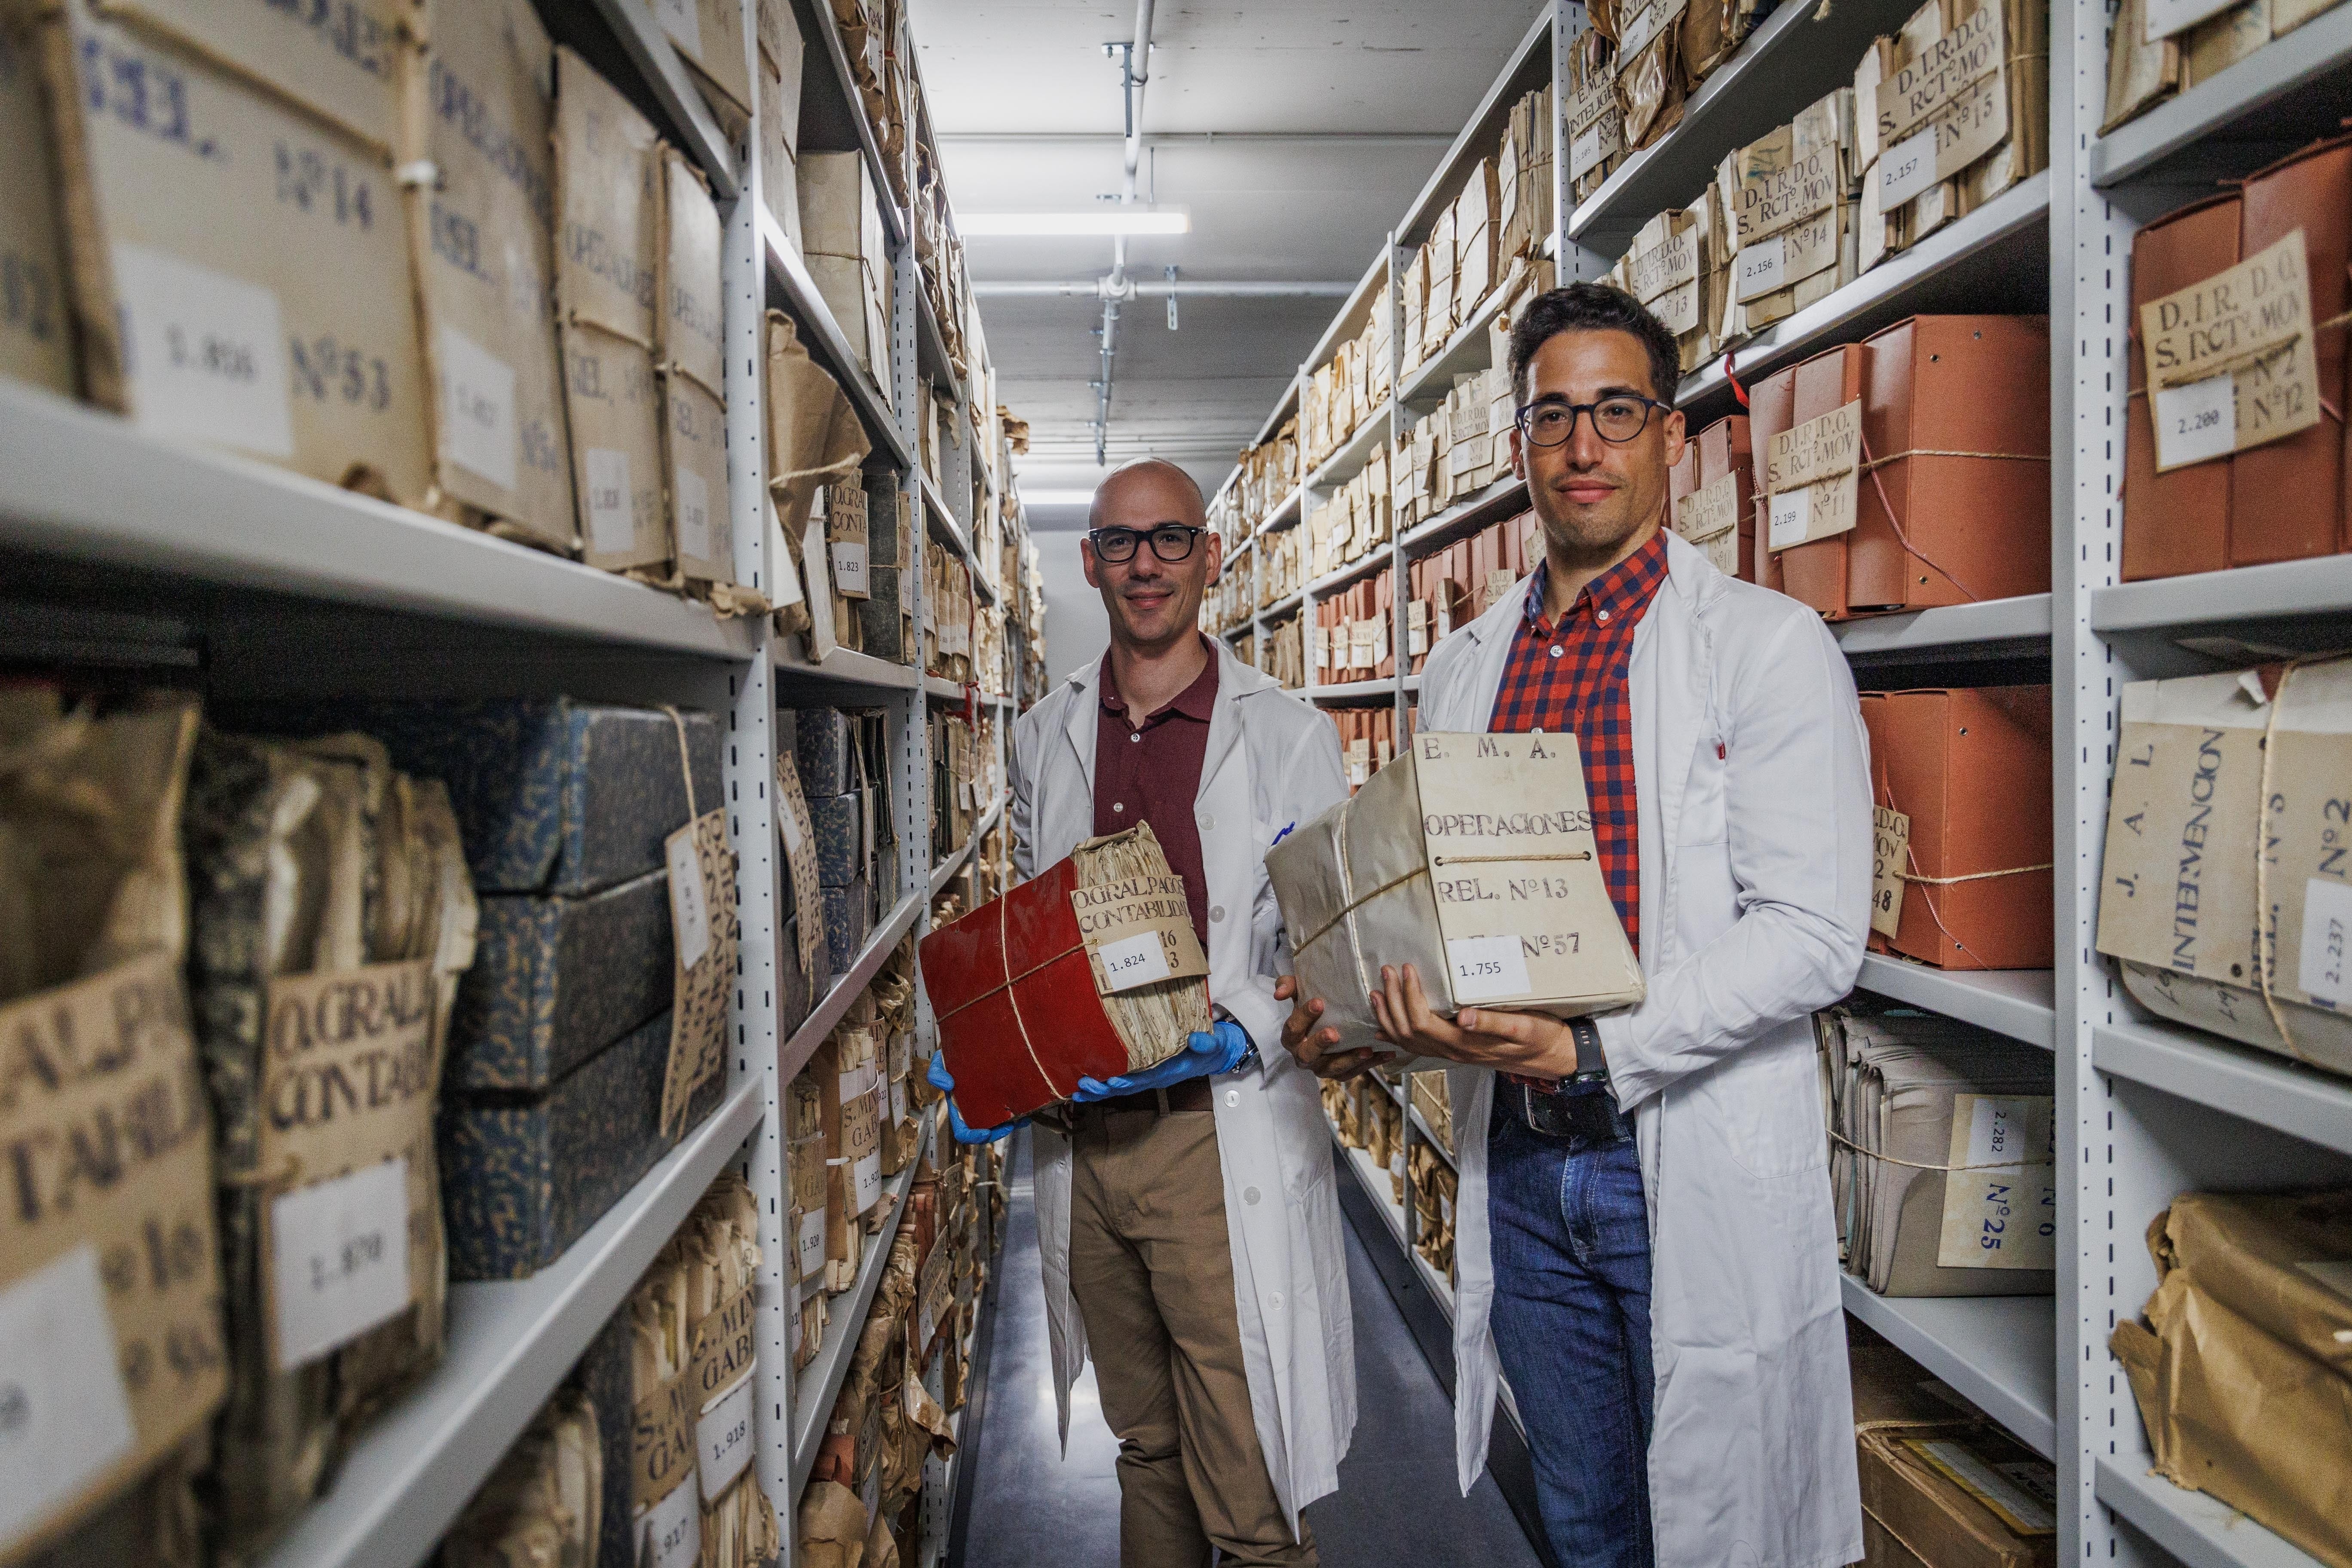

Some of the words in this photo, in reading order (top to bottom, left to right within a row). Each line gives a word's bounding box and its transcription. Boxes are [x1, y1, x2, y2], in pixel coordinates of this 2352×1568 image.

[1575, 148, 1592, 165] 2.105
[1886, 157, 1918, 186] 2.157
[1746, 258, 1773, 277] 2.156
[1774, 511, 1796, 526] 2.199
[838, 560, 859, 572] 1.823
[1424, 809, 1593, 836] OPERACIONES
[1436, 877, 1501, 903] REL.
[1109, 953, 1146, 972] 1.824
[2325, 916, 2344, 985] 2.237
[1459, 962, 1501, 977] 1.755
[1991, 1111, 2007, 1153] 2.282
[1980, 1183, 2012, 1250] Nº25
[713, 1420, 746, 1461] 1.918
